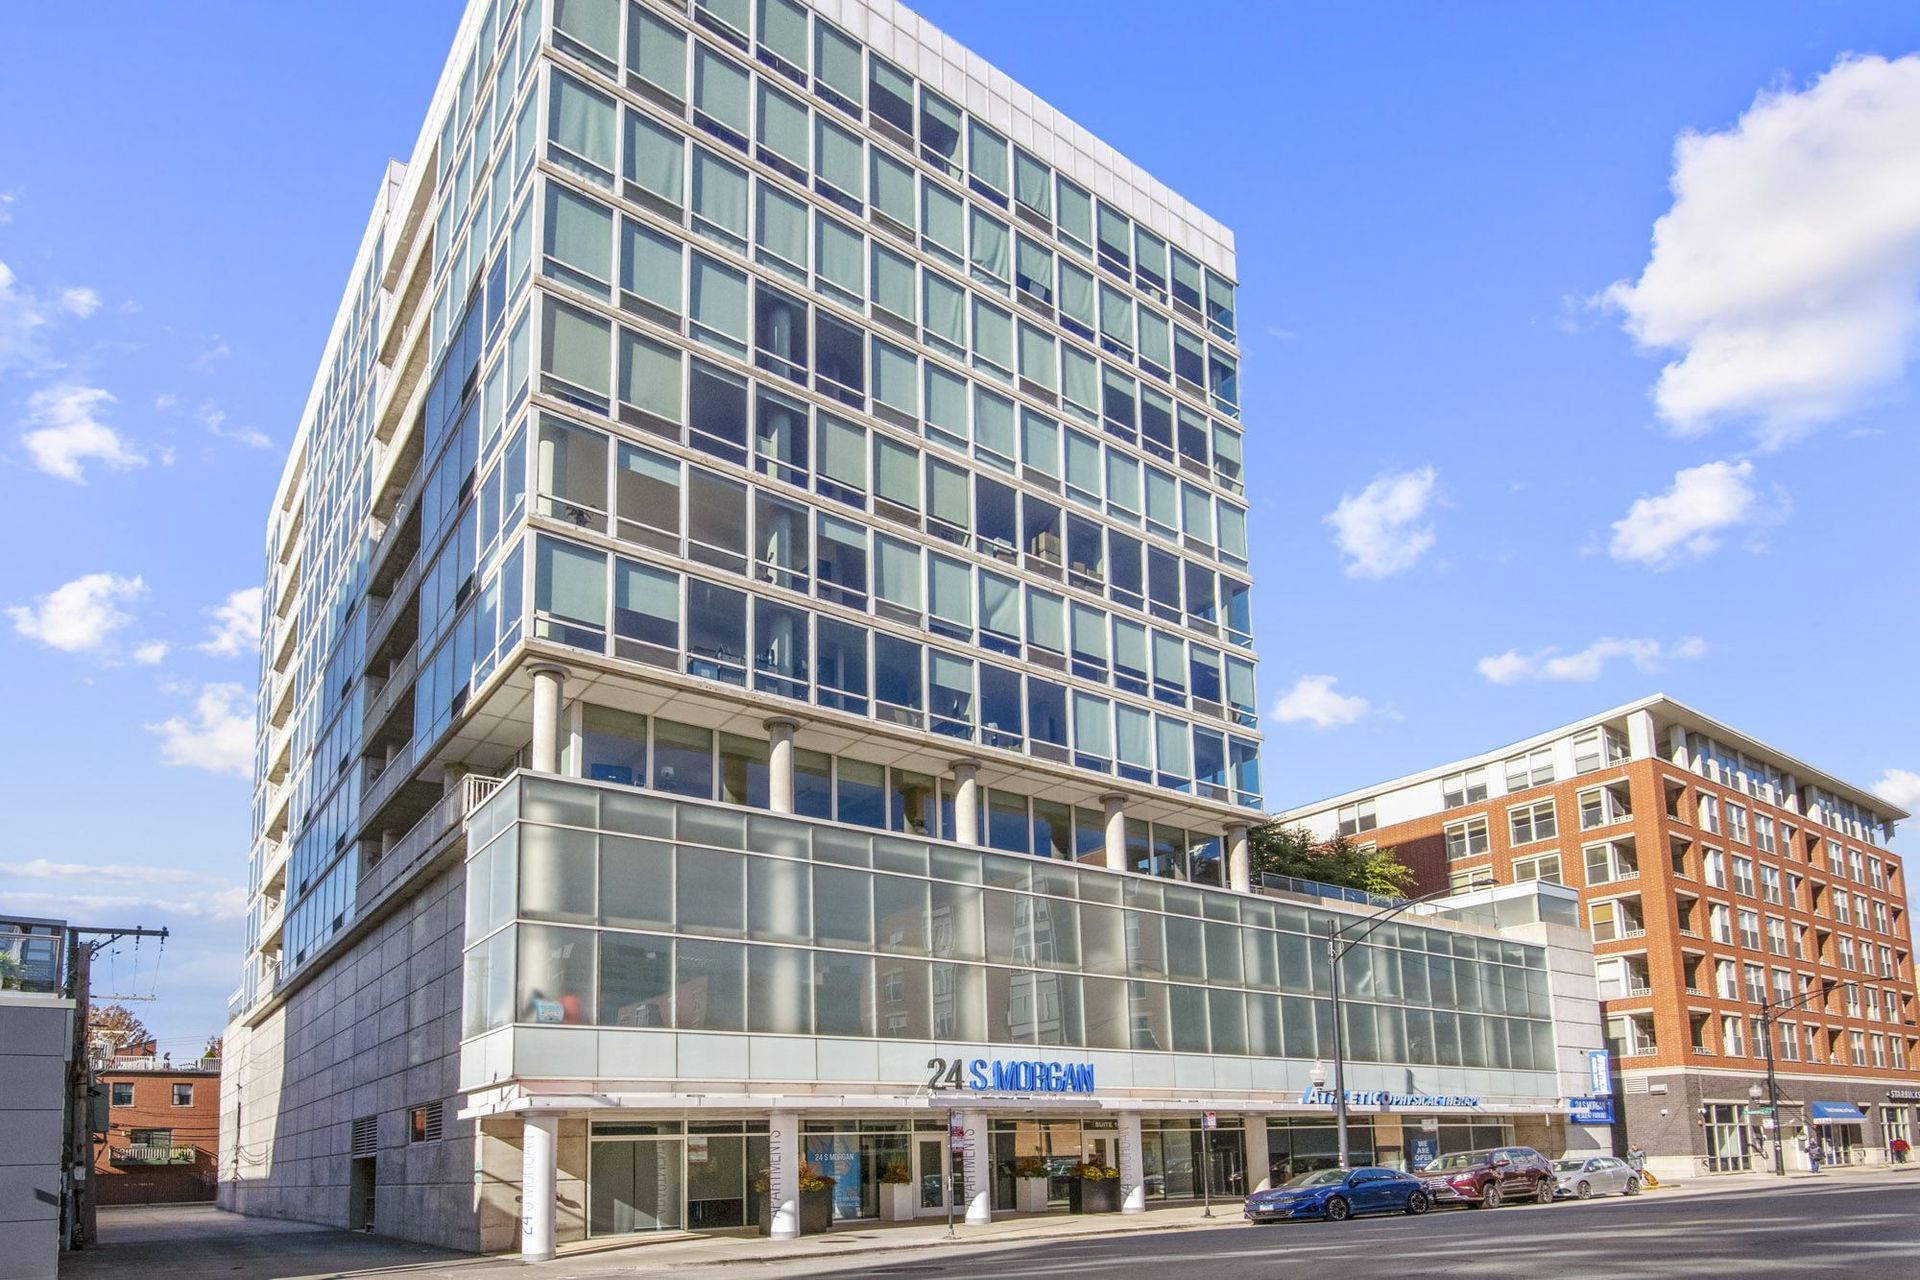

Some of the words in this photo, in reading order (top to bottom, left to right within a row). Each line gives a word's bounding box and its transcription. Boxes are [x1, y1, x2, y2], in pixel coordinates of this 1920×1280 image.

[927, 1058, 965, 1090] 24
[969, 1058, 988, 1091] S
[992, 1059, 1094, 1093] MORGAN
[770, 1129, 781, 1218] APARTMENTS
[814, 1153, 823, 1161] 24
[830, 1153, 855, 1161] MORGAN
[963, 1128, 975, 1208] APARTMENTS
